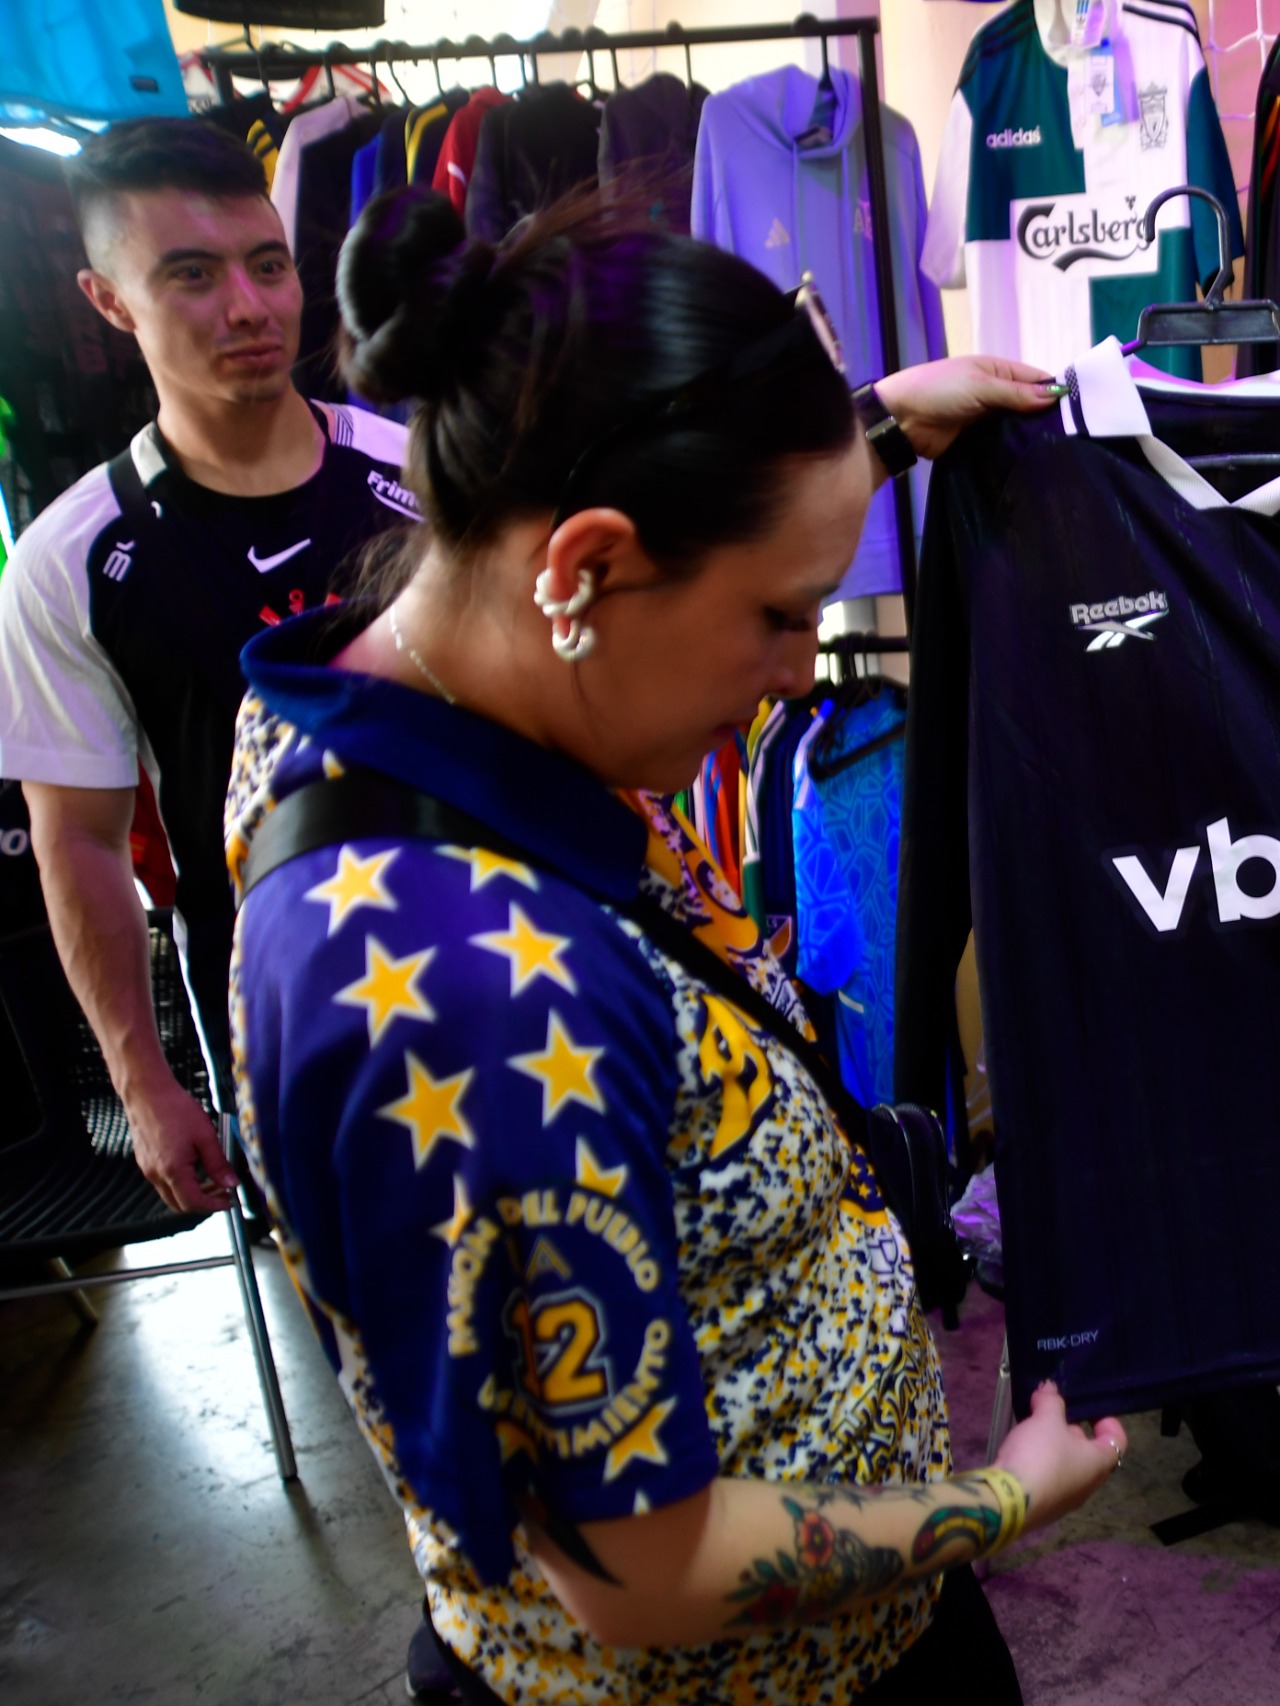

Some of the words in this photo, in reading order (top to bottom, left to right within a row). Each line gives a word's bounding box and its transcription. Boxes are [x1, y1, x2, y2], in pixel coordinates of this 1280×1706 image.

[986, 126, 1041, 149] adidas
[1017, 202, 1154, 260] Carlsberg
[367, 470, 420, 509] Frim
[1070, 591, 1167, 625] Reebok
